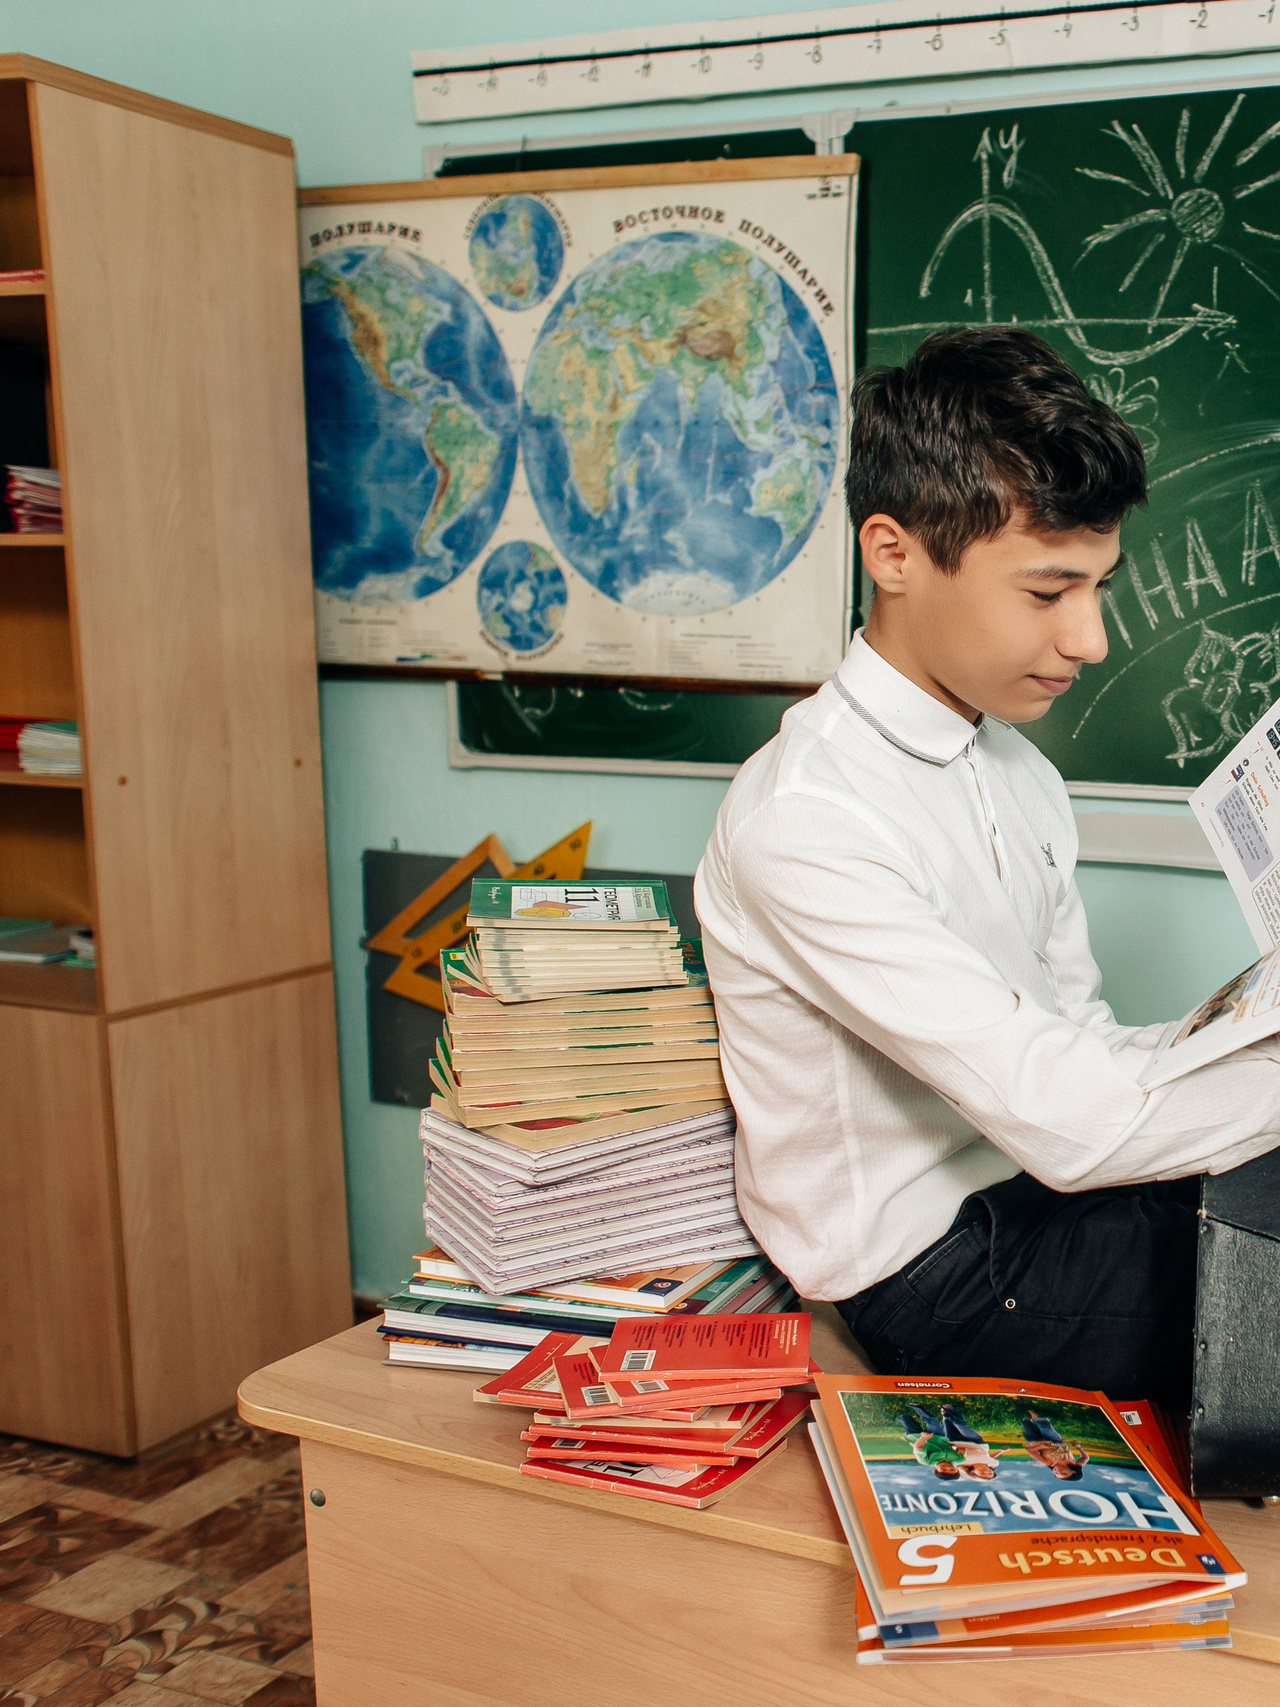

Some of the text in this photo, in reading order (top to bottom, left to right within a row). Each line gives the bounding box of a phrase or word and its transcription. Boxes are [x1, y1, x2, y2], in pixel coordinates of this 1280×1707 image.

[924, 33, 944, 51] -6
[988, 28, 1008, 46] -5
[1120, 15, 1140, 31] -3
[1188, 8, 1208, 29] -2
[1257, 4, 1275, 24] -1
[309, 219, 424, 249] ПОЛУШАРИЕ
[612, 204, 836, 318] ВОСТОЧНОЕ ПОЛУШАРИЕ
[1250, 771, 1269, 807] Dein Schultag
[564, 887, 600, 902] 11
[603, 887, 621, 920] ГЕОМЕТРИЯ
[896, 1380, 951, 1389] Cornelsen
[878, 1488, 1200, 1535] HORIZONTE
[900, 1523, 971, 1535] Lehrbuch
[1029, 1533, 1144, 1547] Fremdsprache
[1161, 1535, 1183, 1545] als
[896, 1534, 958, 1586] 5
[997, 1546, 1187, 1574] Deutsch
